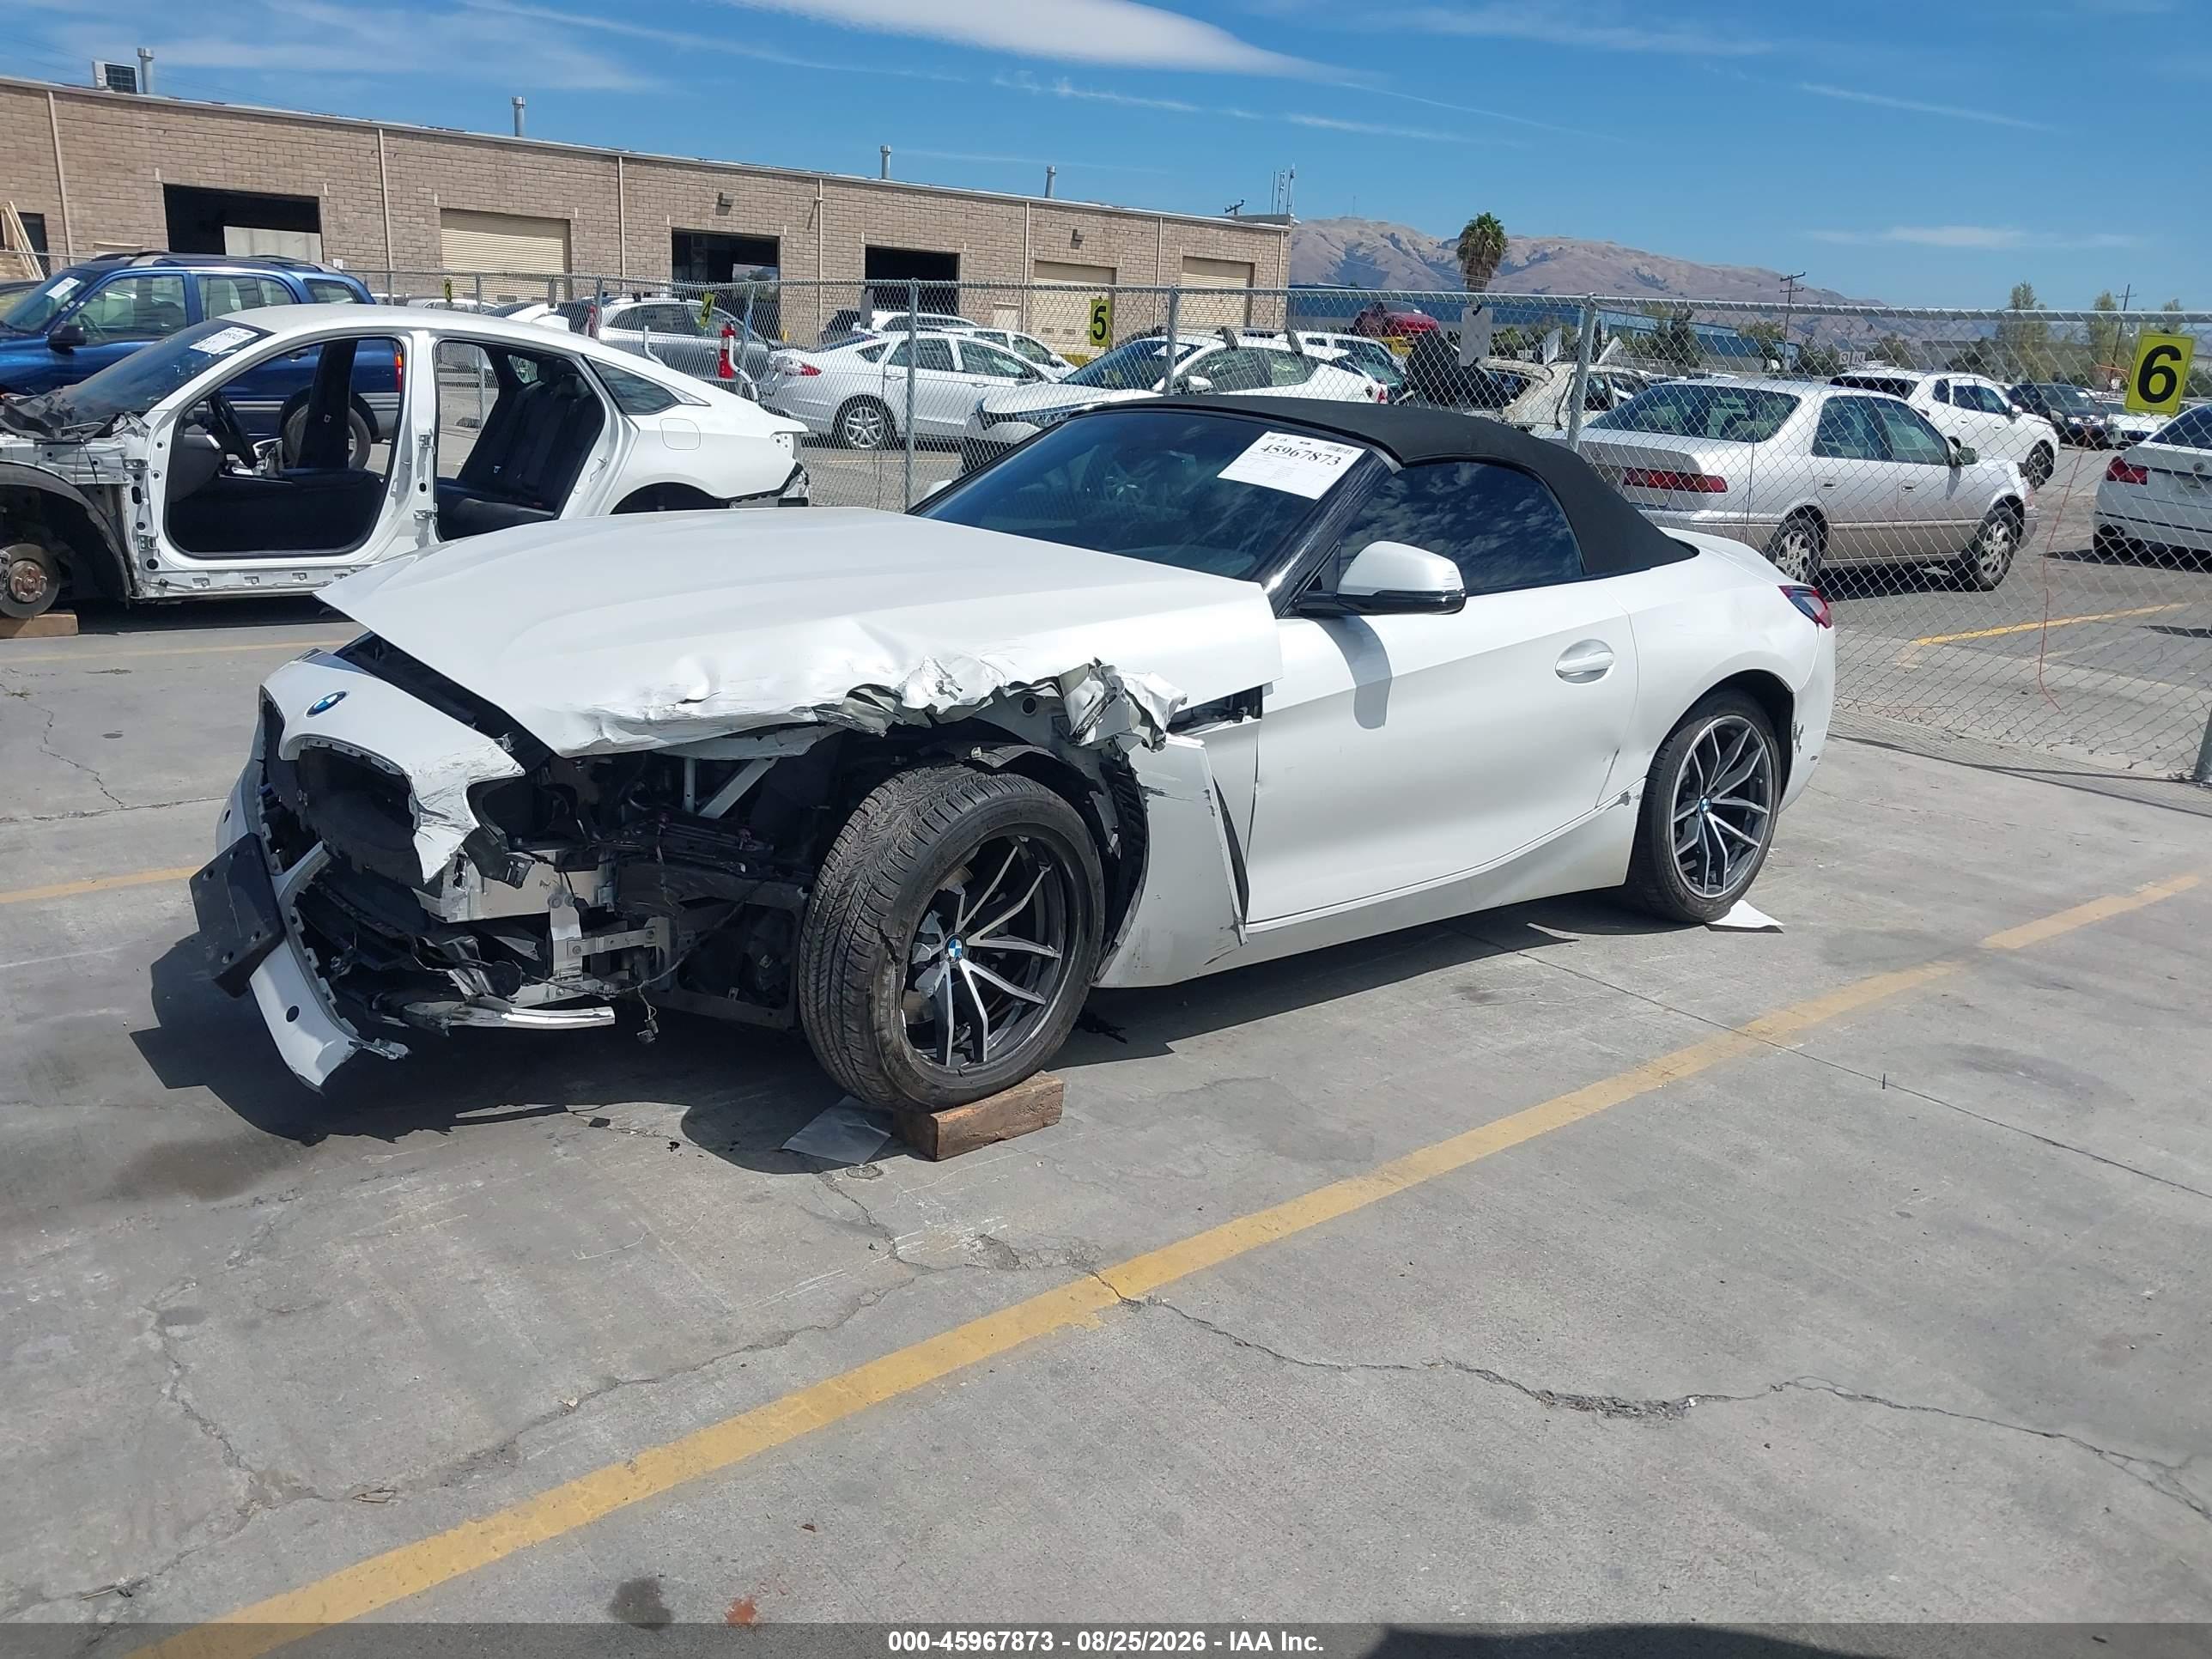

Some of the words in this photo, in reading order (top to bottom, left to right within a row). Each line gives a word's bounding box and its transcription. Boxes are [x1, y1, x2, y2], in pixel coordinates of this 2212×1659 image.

[445, 283, 452, 302] 3
[702, 298, 712, 323] 4
[1092, 305, 1107, 341] 5
[2137, 344, 2182, 404] 6
[1261, 443, 1342, 465] 45967873
